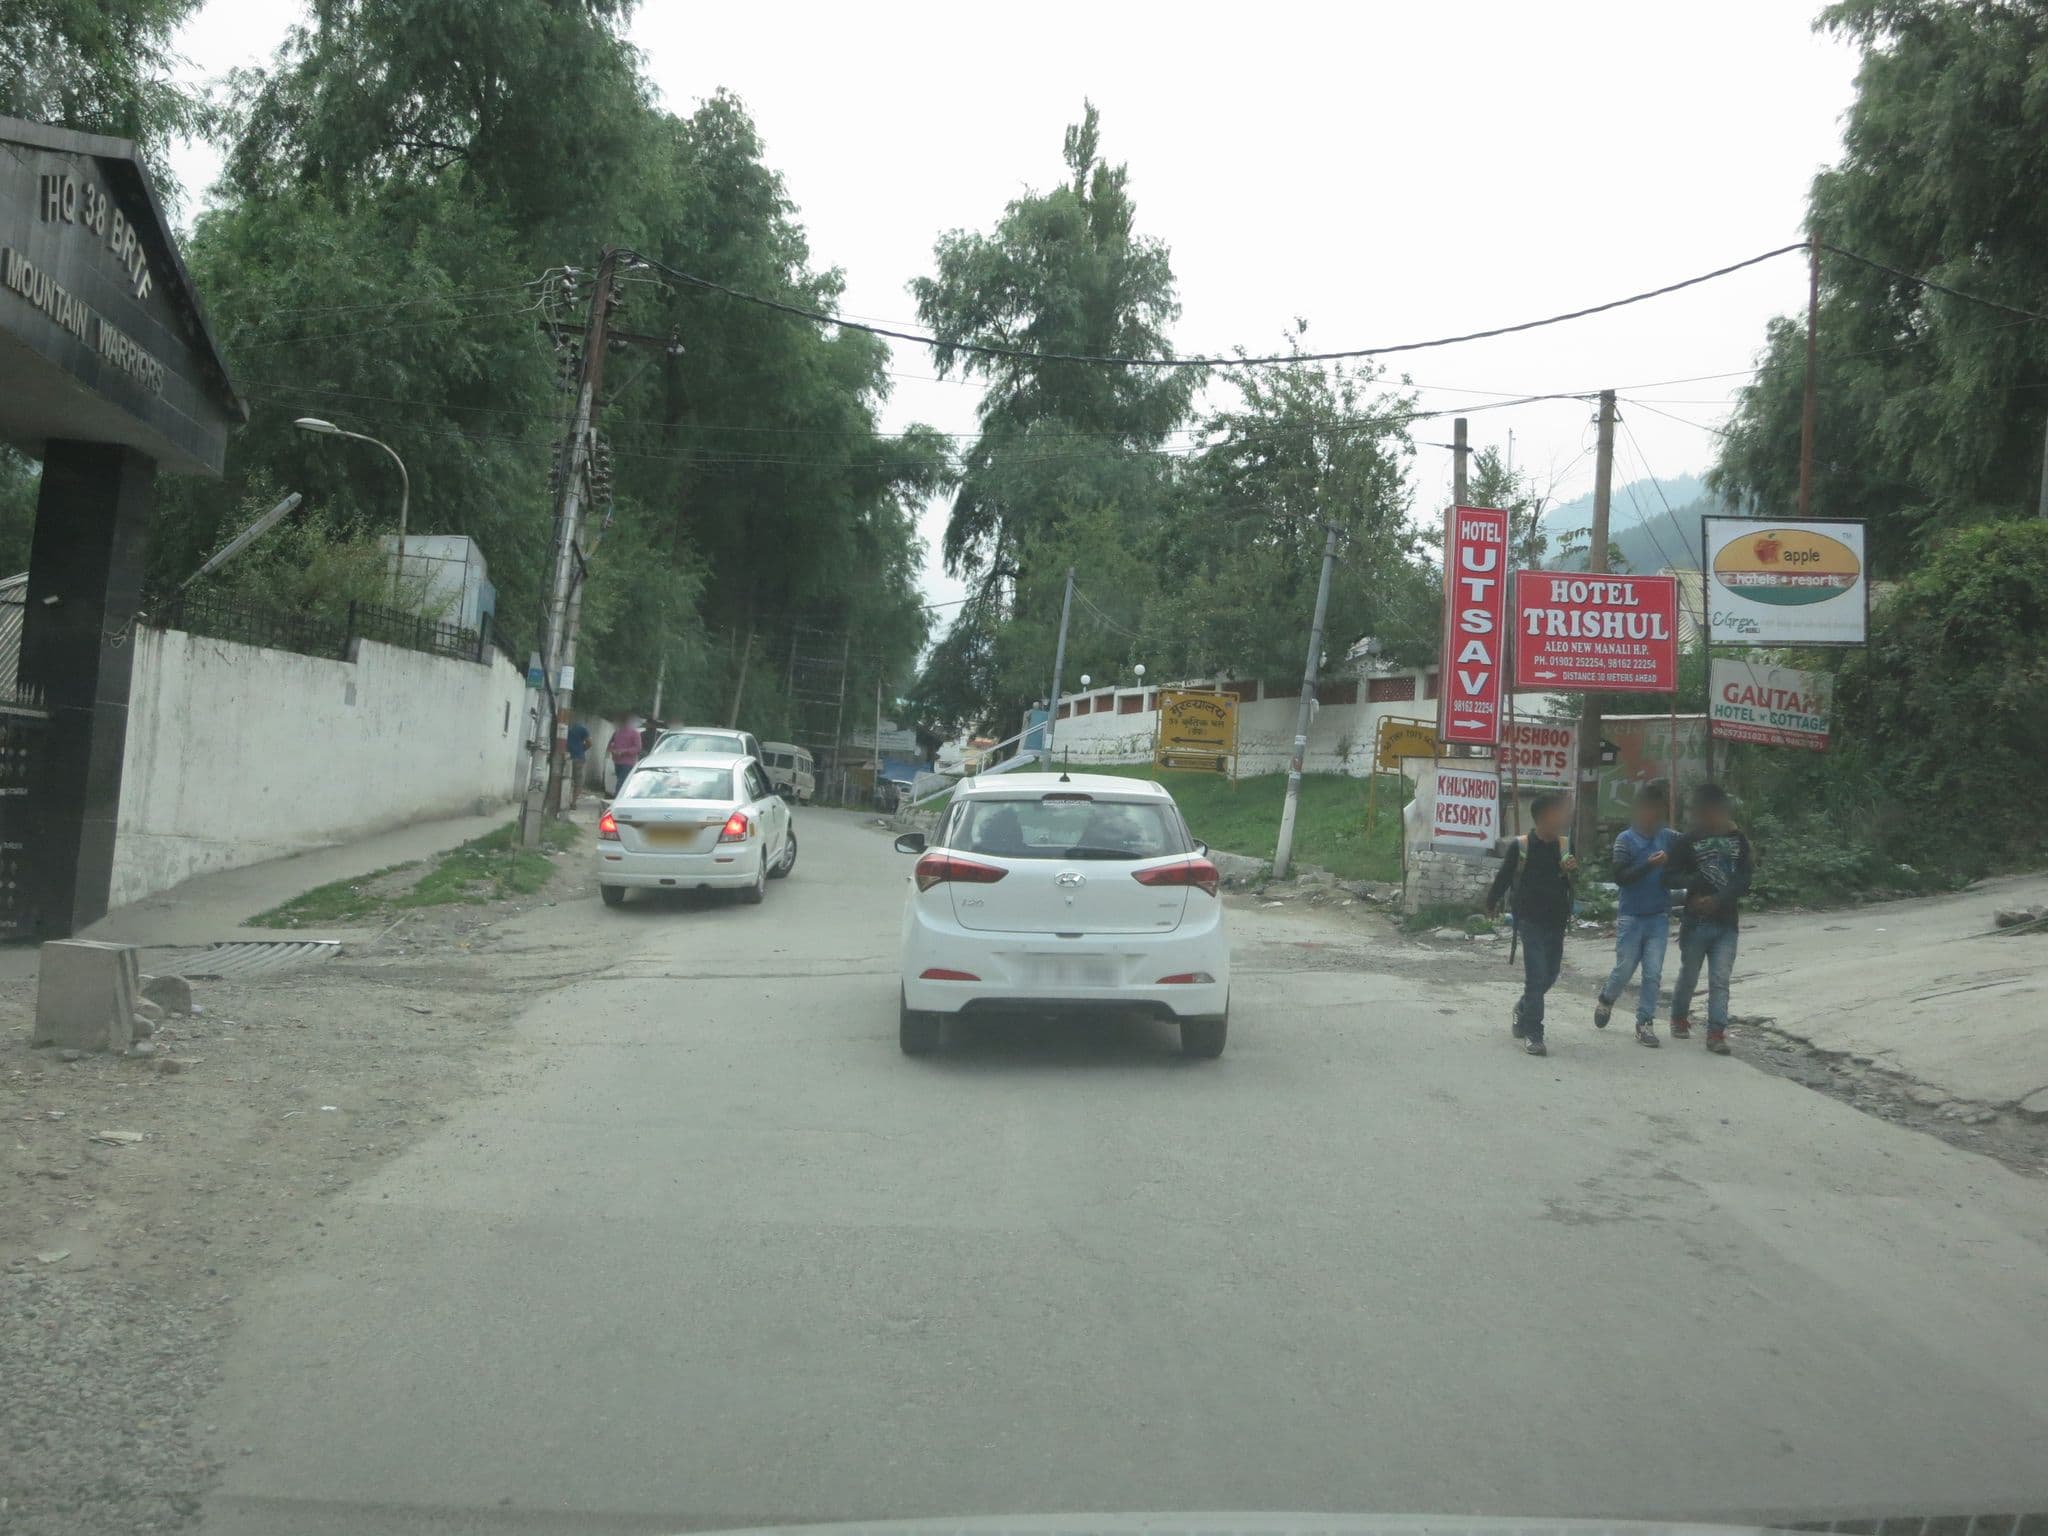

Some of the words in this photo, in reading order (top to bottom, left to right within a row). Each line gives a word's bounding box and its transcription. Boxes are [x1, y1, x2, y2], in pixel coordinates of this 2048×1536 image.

[46, 174, 77, 225] HQ
[84, 183, 107, 237] 38
[111, 207, 153, 300] BRTF
[5, 247, 90, 341] MOUNTAIN
[98, 321, 165, 395] WARRIORS
[1461, 520, 1501, 543] HOTEL
[1784, 548, 1820, 565] apple
[1736, 573, 1777, 585] hotels
[1791, 575, 1840, 586] resorts
[1550, 579, 1639, 606] HOTEL
[1457, 547, 1497, 696] UTSAV
[1522, 607, 1670, 641] TRISHUL
[1544, 641, 1569, 652] ALEO
[1571, 642, 1592, 653] NEW
[1594, 643, 1631, 655] MANALI
[1562, 671, 1596, 682] DISTANCE
[1714, 704, 1755, 722] HOTEL
[1437, 775, 1496, 801] KHUSHBOO
[1435, 803, 1492, 827] RESORTS
